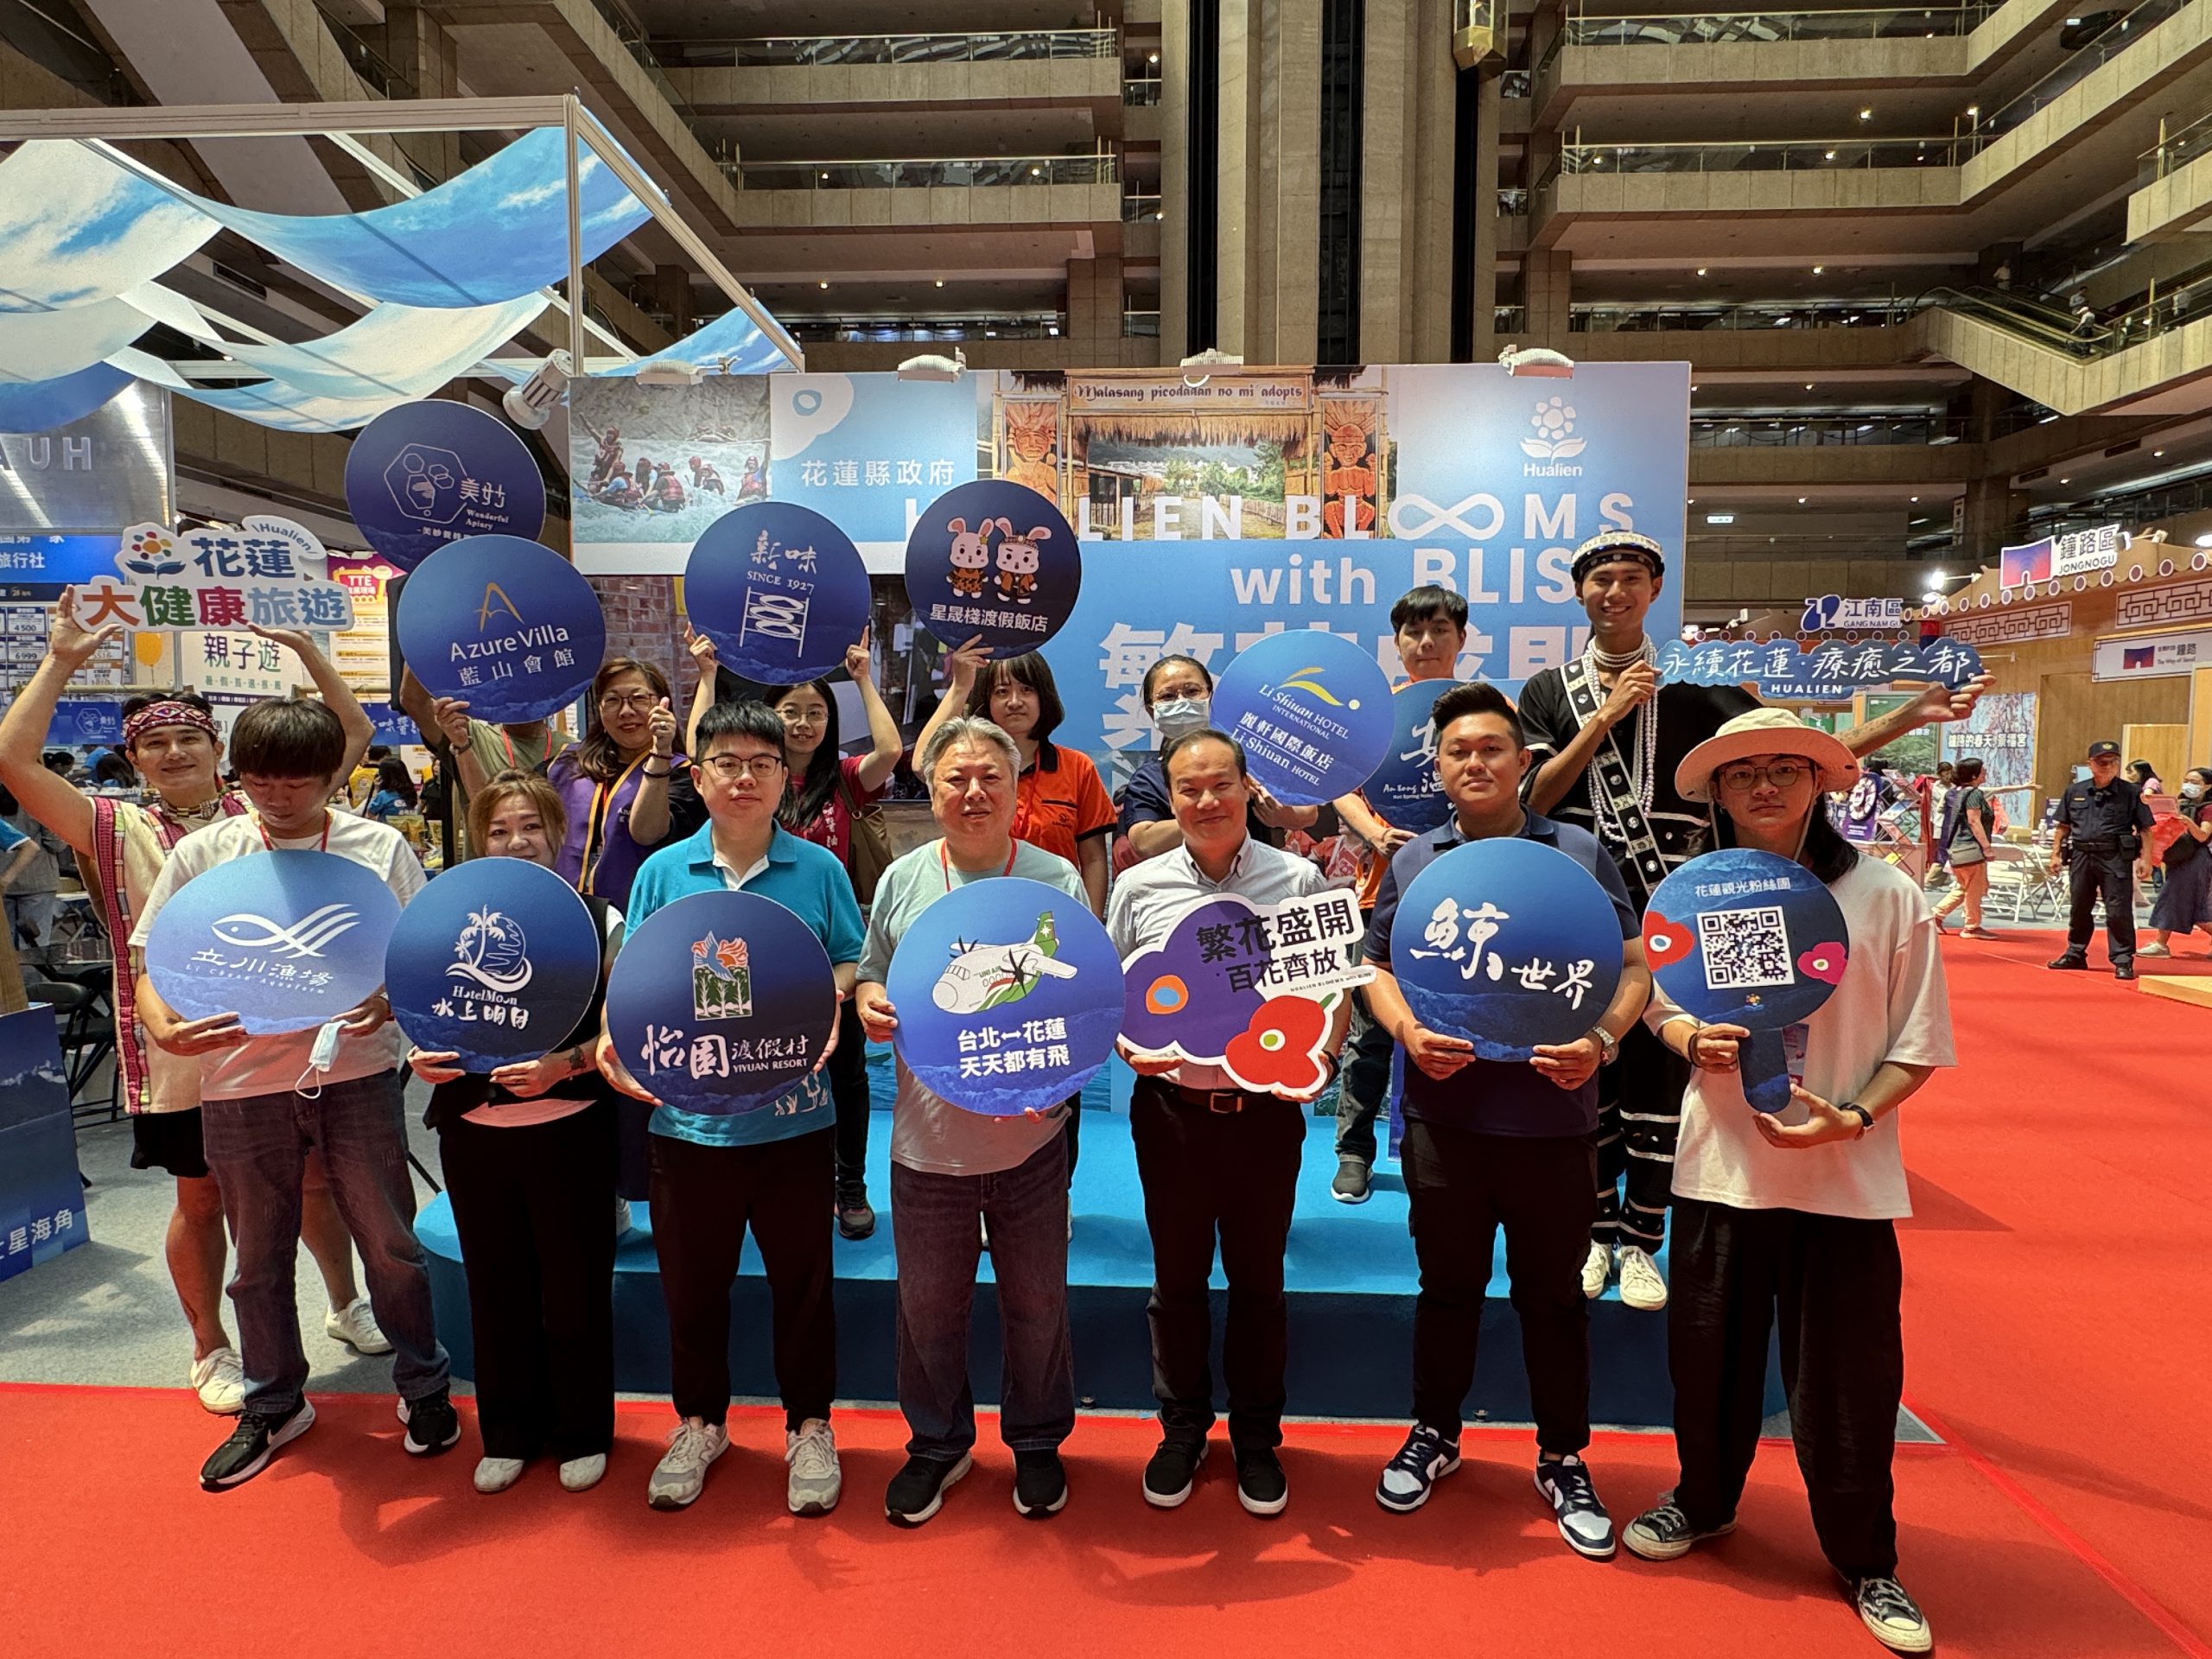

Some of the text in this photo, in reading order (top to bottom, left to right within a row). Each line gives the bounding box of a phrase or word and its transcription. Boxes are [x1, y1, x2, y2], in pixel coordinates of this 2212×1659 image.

[1218, 388, 1232, 397] no
[801, 459, 955, 486] 花蓮縣政府
[1523, 463, 1582, 477] Hualien
[259, 523, 312, 551] Hualien
[750, 529, 817, 575] 新味
[191, 537, 296, 580] 花蓮
[1230, 547, 1574, 604] with BLIS
[2059, 555, 2114, 574] JONGNOGU
[347, 575, 372, 587] TTE
[747, 570, 814, 595] SINCE 1927
[82, 585, 347, 626] 大健康旅遊
[930, 605, 1048, 632] 星晟棧渡假飯店
[1844, 599, 1901, 617] 江南區
[204, 632, 282, 673] 親子遊
[450, 625, 569, 663] Azure Villa
[457, 648, 575, 687] 藍山會館
[1771, 684, 1843, 695] HUALIEN
[1259, 683, 1349, 740] Li Shiuan HOTEL
[1272, 704, 1331, 740] INTERNATIONAL
[1230, 728, 1320, 786] Li Shiuan HOTEL
[1695, 877, 1791, 898] 花蓮觀光粉絲團
[1196, 899, 1355, 964] 繁花盛開
[190, 948, 334, 987] 立川漁場
[1226, 946, 1341, 992] 百花齊放
[432, 997, 530, 1030] 水上明月
[641, 1023, 730, 1080] 怡園
[733, 1057, 809, 1073] YIYUAN RESORT
[959, 1044, 1071, 1079] 天天都有飛
[0, 1209, 73, 1260] 星海角
